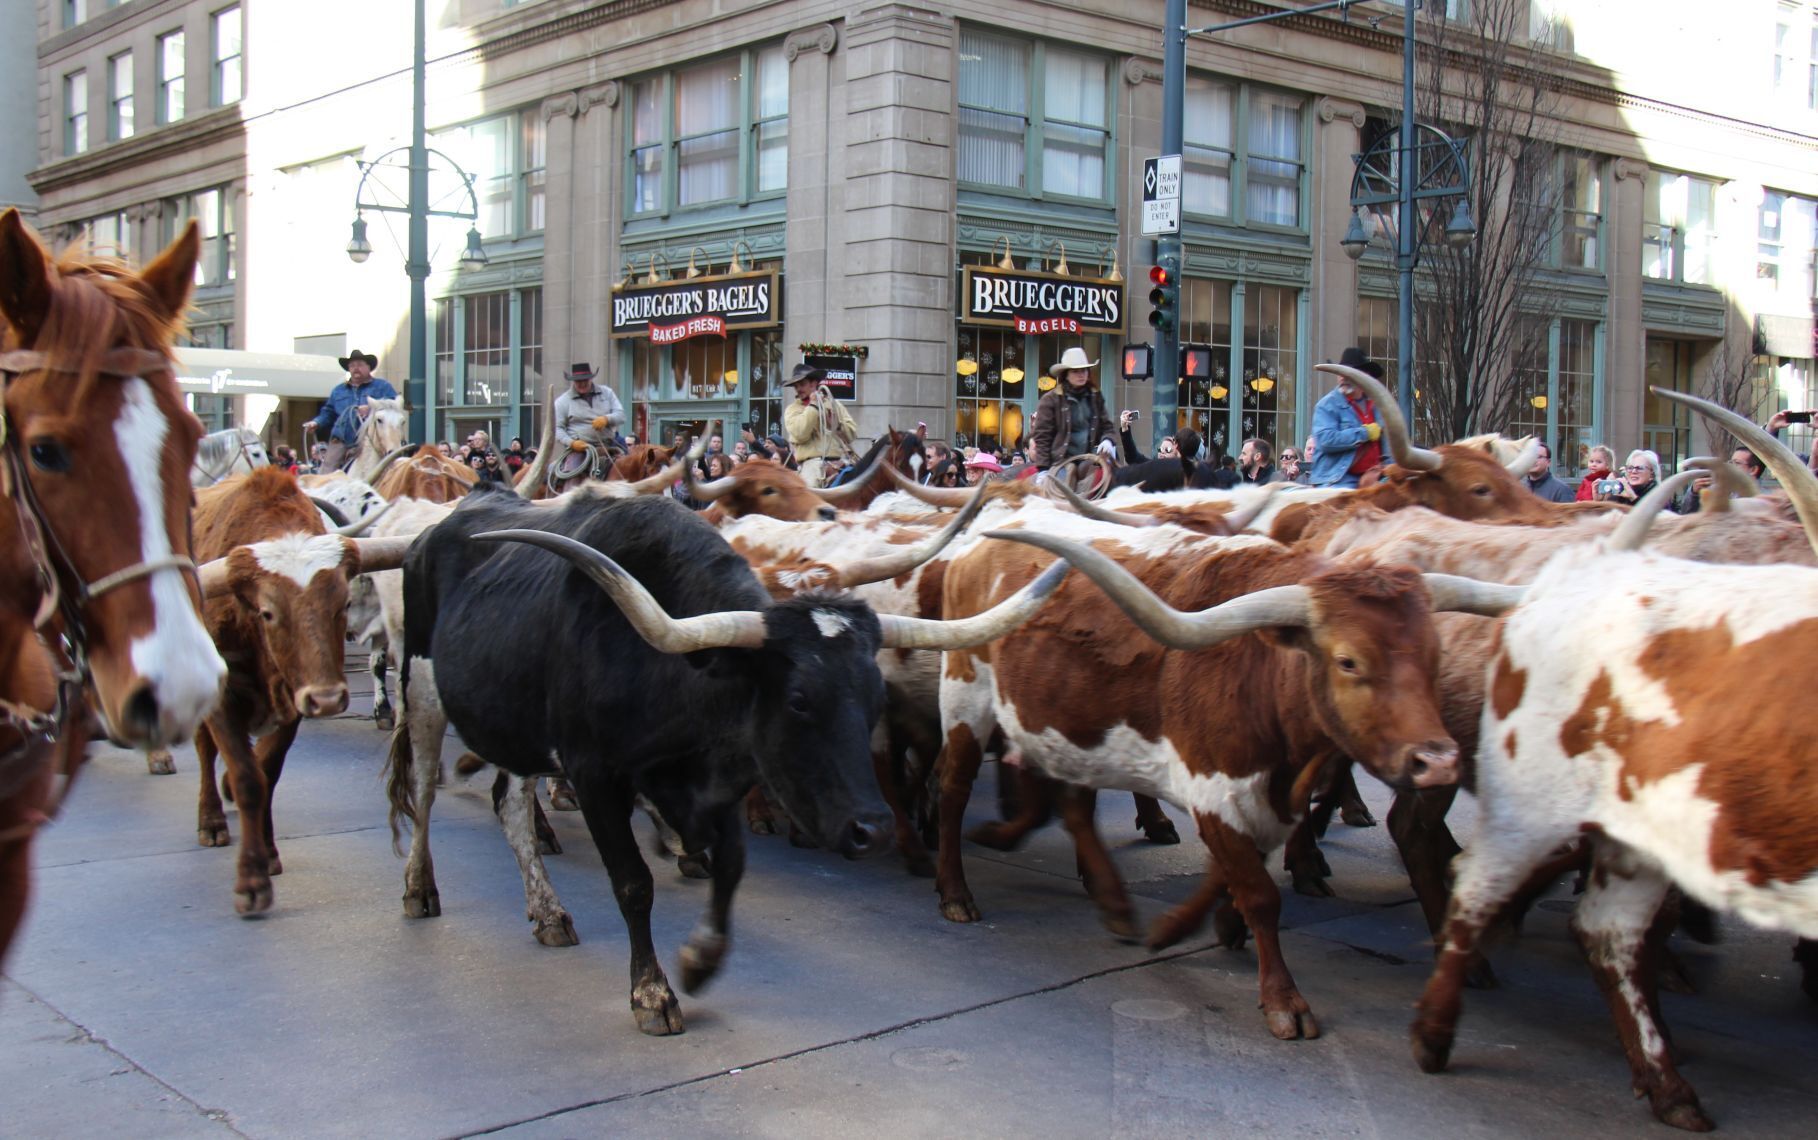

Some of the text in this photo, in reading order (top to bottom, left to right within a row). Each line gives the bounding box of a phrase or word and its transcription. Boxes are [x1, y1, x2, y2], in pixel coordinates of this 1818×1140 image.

[1159, 172, 1178, 184] TRAIN
[1159, 184, 1177, 196] ONLY
[1150, 201, 1172, 211] DO NOT
[1151, 211, 1170, 221] ENTER
[614, 283, 769, 327] BRUEGGER'S BAGELS
[973, 276, 1119, 324] BRUEGGER'S
[652, 319, 721, 342] BAKED FRESH
[1018, 318, 1077, 333] BAGELS
[826, 371, 855, 380] GGER'S
